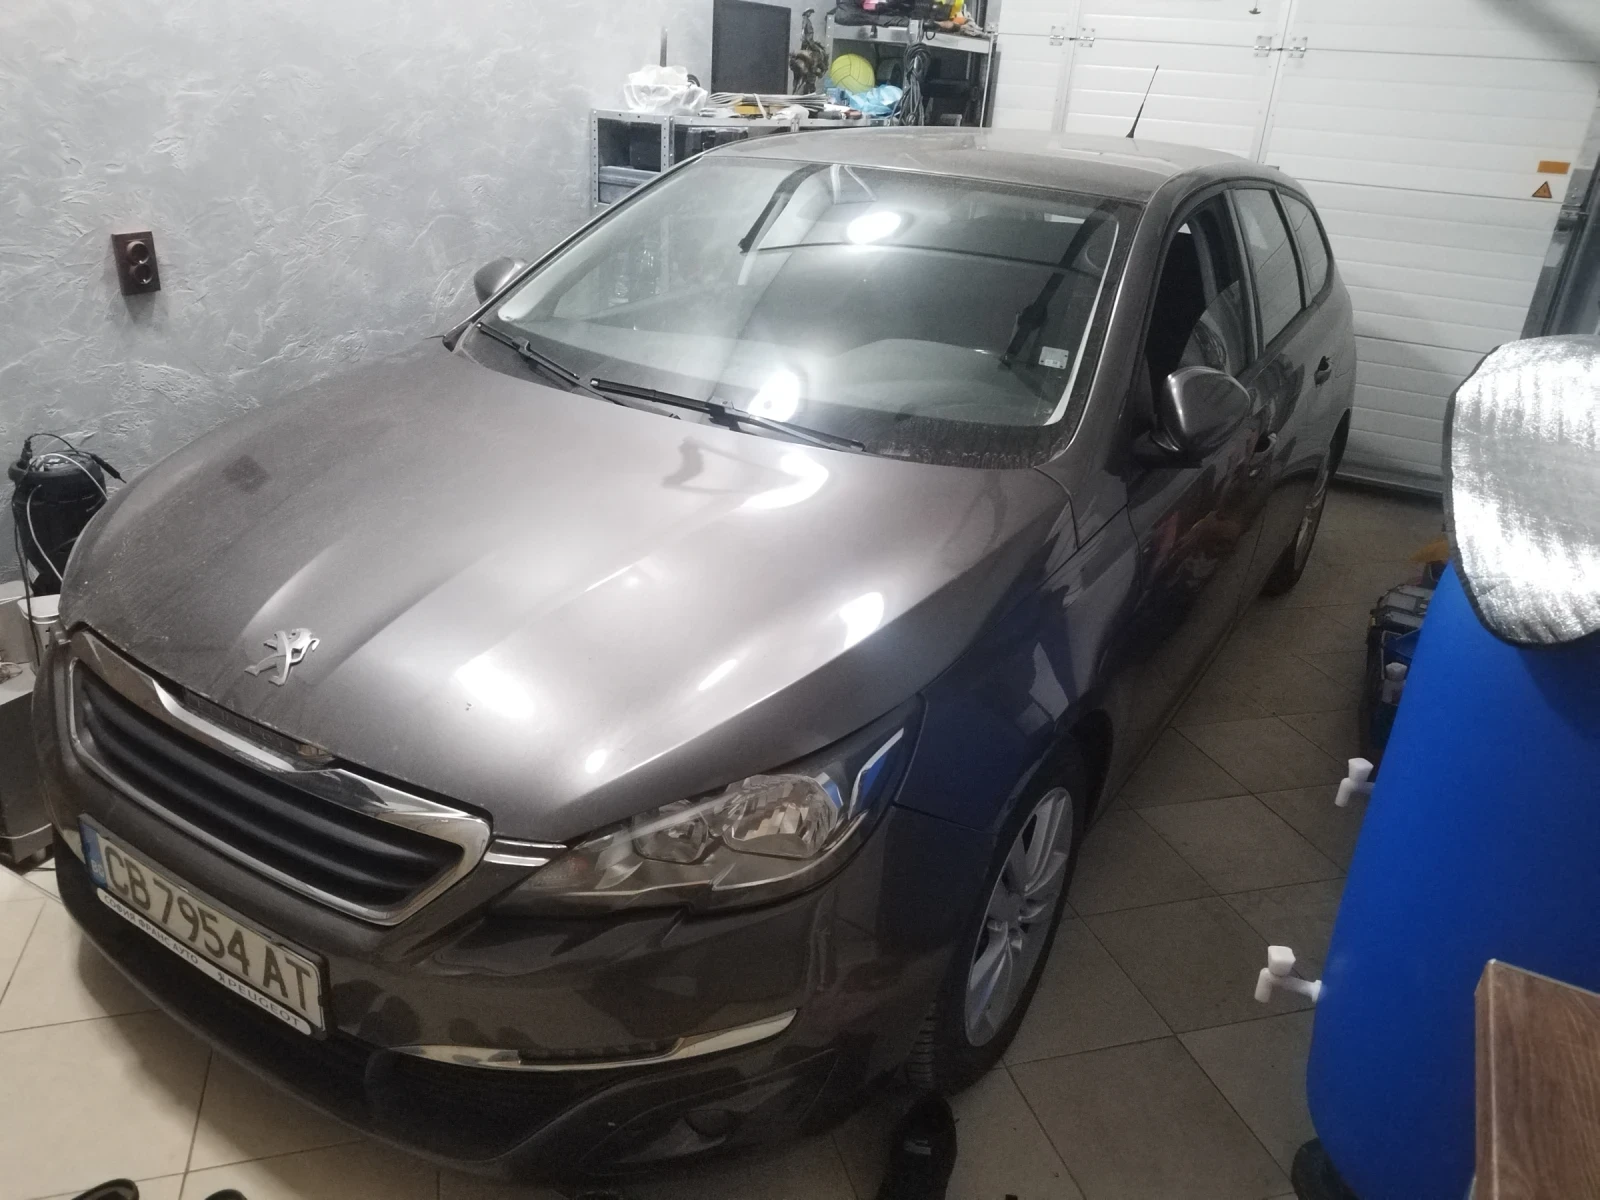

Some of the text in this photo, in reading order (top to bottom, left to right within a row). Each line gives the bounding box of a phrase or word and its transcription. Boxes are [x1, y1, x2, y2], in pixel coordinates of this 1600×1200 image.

[92, 860, 105, 878] BG
[104, 845, 310, 1012] CB 7954 AT
[104, 894, 199, 965] СОФИЯ ФРАНС АУТО
[228, 980, 300, 1027] PEUGEOT
